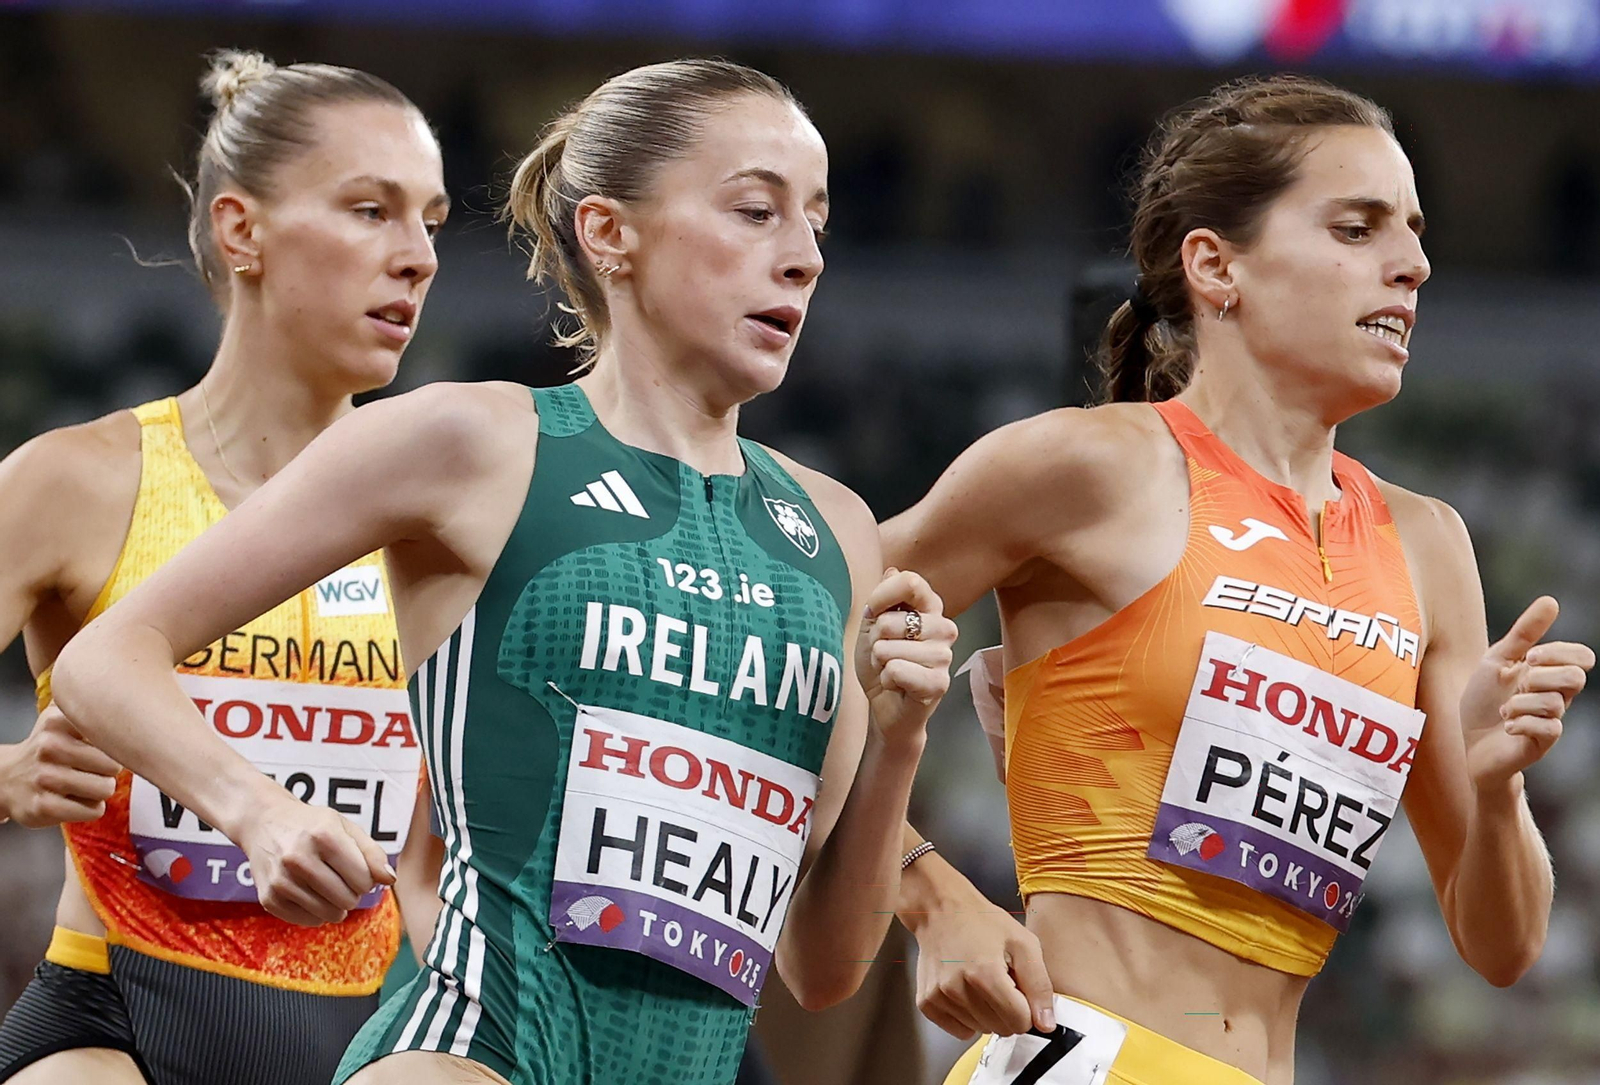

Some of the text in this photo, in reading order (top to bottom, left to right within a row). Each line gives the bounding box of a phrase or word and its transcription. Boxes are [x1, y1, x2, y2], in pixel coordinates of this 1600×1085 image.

[318, 578, 380, 603] WGV
[1201, 575, 1419, 669] ESPAÑA
[579, 601, 841, 723] IRELAND
[1200, 658, 1419, 775] HONDA
[579, 728, 814, 842] HONDA
[1195, 745, 1391, 871] PÉREZ
[586, 807, 792, 934] HEALY
